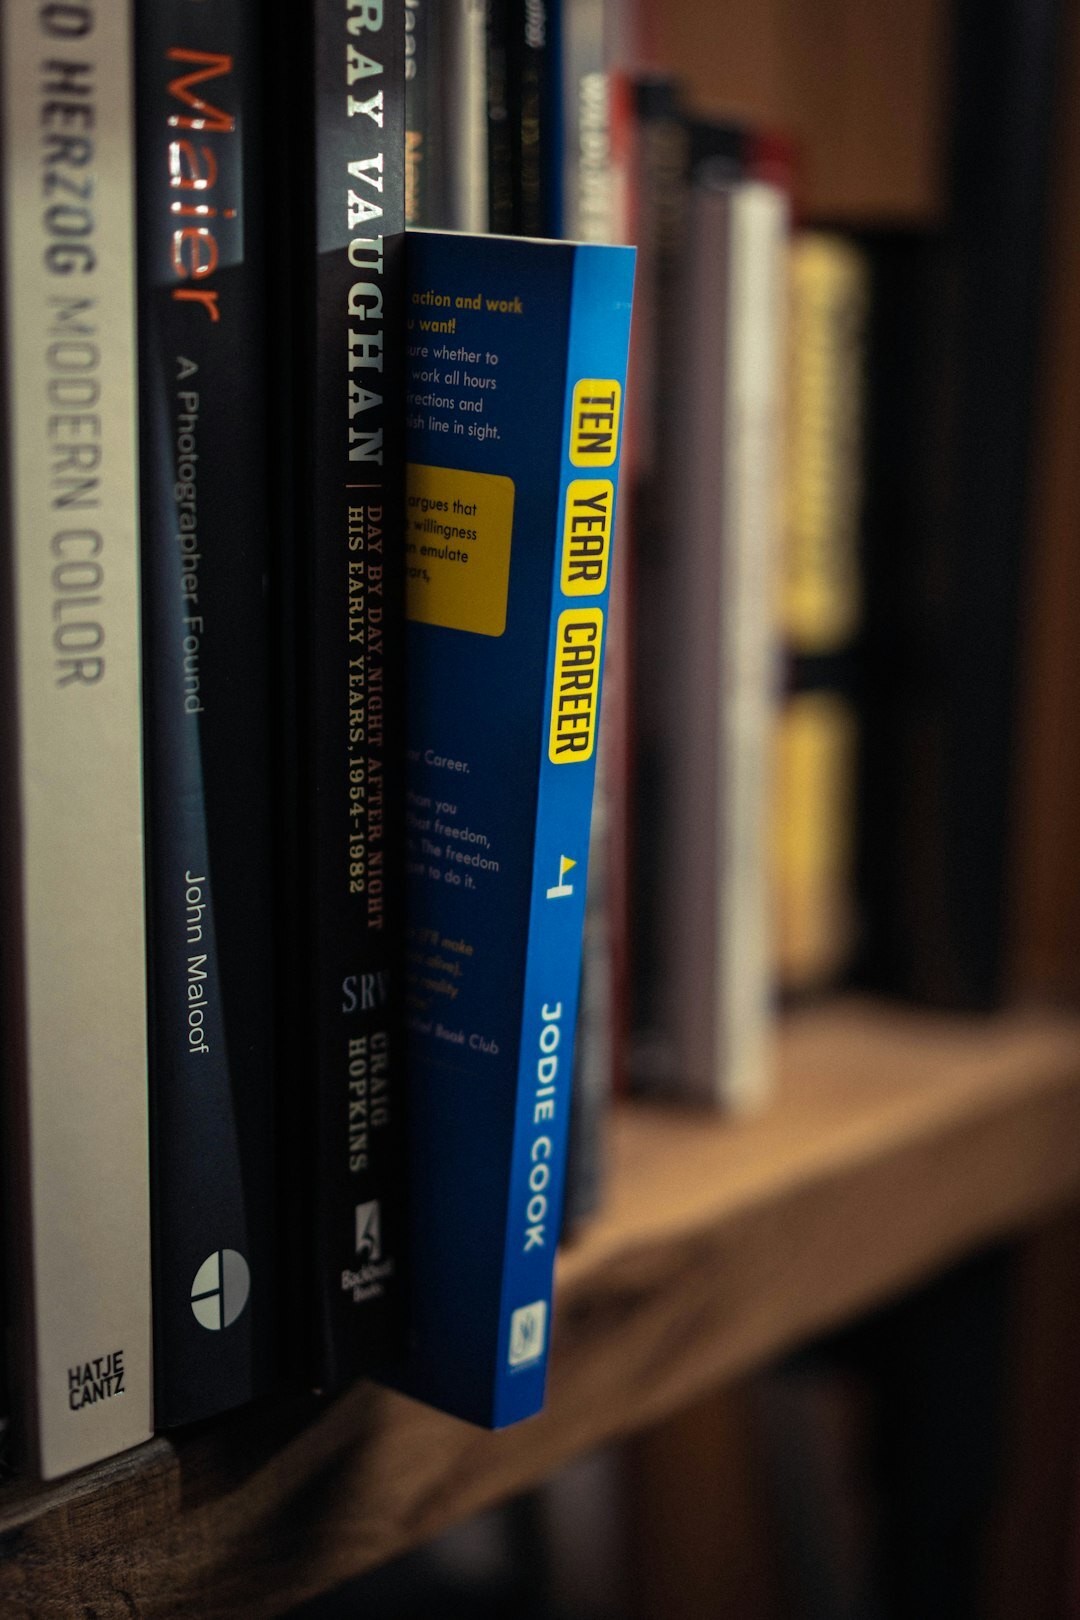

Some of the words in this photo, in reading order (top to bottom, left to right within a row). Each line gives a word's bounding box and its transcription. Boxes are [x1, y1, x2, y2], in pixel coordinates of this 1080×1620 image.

[346, 0, 384, 128] RAY
[43, 58, 96, 277] HERZOG
[165, 46, 237, 324] Maier
[347, 152, 384, 467] VAUGHAN
[411, 289, 451, 308] action
[455, 293, 483, 311] and
[486, 296, 523, 315] work
[418, 317, 457, 334] want!
[176, 354, 199, 381] A
[412, 368, 441, 384] work
[444, 370, 460, 387] all
[463, 371, 497, 390] hours
[433, 345, 482, 364] whether
[485, 351, 499, 366] to
[45, 295, 102, 512] MODERN
[428, 416, 449, 433] line
[453, 419, 464, 434] in
[468, 422, 501, 442] sight.
[459, 397, 484, 413] and
[577, 391, 616, 453] TEN
[173, 390, 202, 605] Photographer
[349, 504, 364, 552] HIS
[408, 496, 448, 513] argues
[453, 499, 477, 516] that
[367, 504, 384, 555] DAY
[414, 517, 477, 541] willingness
[420, 545, 469, 563] emulate
[568, 491, 608, 582] YEAR
[50, 528, 106, 689] COLOR
[349, 561, 365, 646] EARLY
[367, 564, 384, 598] BY
[366, 606, 384, 662] DAY,
[182, 615, 205, 717] Found
[556, 621, 598, 755] CAREER
[347, 655, 365, 751] YEARS,
[367, 666, 384, 748] NIGHT
[424, 749, 471, 774] Career.
[349, 755, 366, 895] 1954-1982
[367, 756, 384, 843] AFTER
[435, 799, 458, 816] you
[433, 818, 491, 850] freedom,
[445, 845, 500, 873] freedom
[185, 869, 207, 943] John
[367, 850, 384, 930] NIGHT
[429, 865, 441, 881] to
[444, 868, 462, 886] do
[464, 872, 477, 891] it.
[187, 953, 210, 1055] Maloof
[468, 1033, 500, 1056] Club
[533, 1001, 563, 1125] JODIE
[349, 1034, 369, 1174] HOPKINS
[370, 1030, 392, 1130] CRAIG
[523, 1134, 554, 1252] COOK
[67, 1350, 124, 1390] HATJE
[69, 1371, 125, 1411] CANTZ
